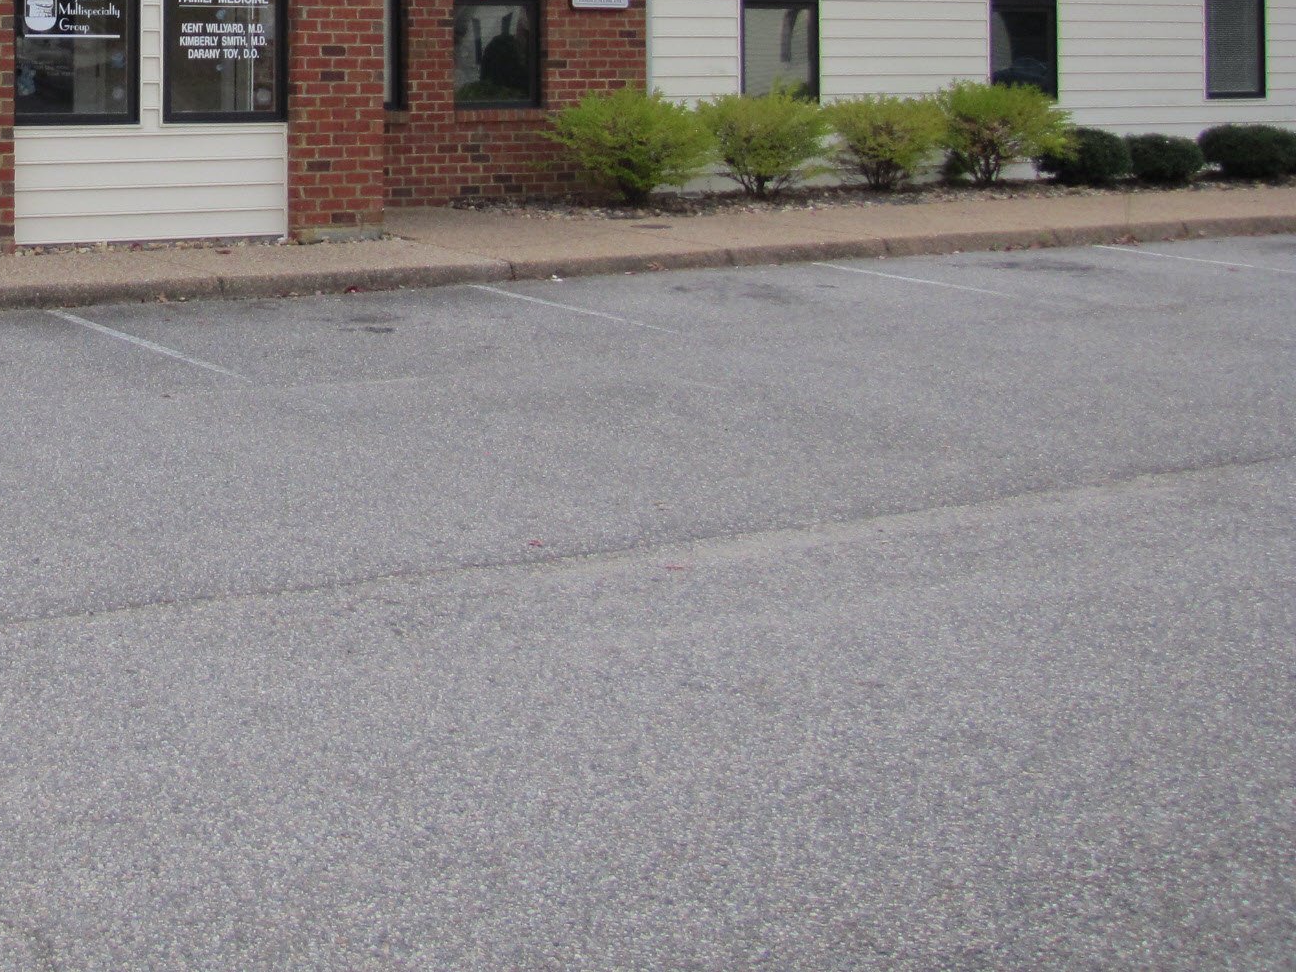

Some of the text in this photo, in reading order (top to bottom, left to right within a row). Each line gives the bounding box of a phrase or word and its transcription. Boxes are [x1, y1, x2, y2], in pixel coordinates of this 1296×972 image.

[59, 2, 120, 19] Multispecialty
[59, 17, 90, 35] Group
[181, 23, 265, 35] KENT WILLYARD, M.D.
[179, 36, 268, 48] KIMBERLY SMITH, M.D.
[188, 49, 260, 60] DARANY TOY, D.O.
